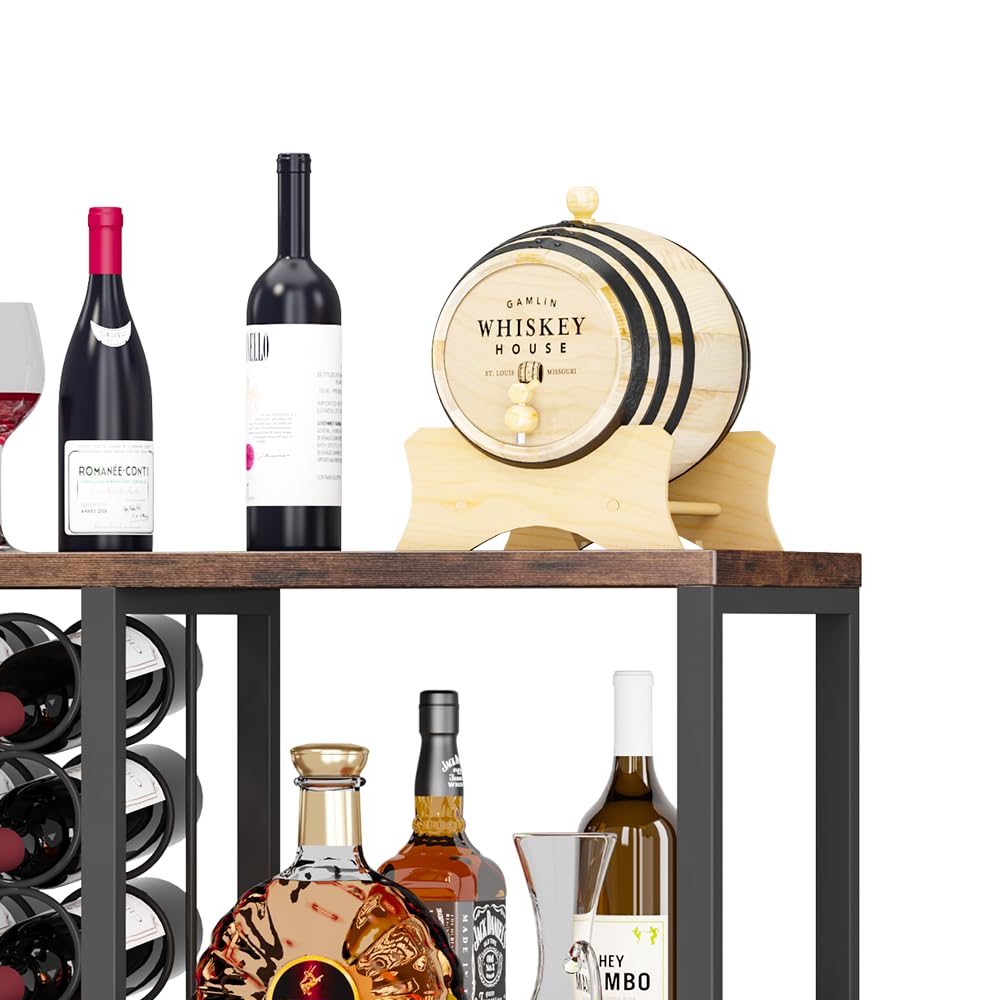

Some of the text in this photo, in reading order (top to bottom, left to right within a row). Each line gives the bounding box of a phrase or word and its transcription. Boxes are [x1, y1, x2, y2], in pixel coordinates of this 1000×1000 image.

[506, 296, 557, 309] GAMLIN
[477, 316, 586, 338] WHISKEY
[495, 342, 567, 355] HOUSE
[496, 369, 515, 377] LOUIS
[78, 464, 150, 477] ROMANÉE-CONTI
[599, 954, 625, 968] HEY
